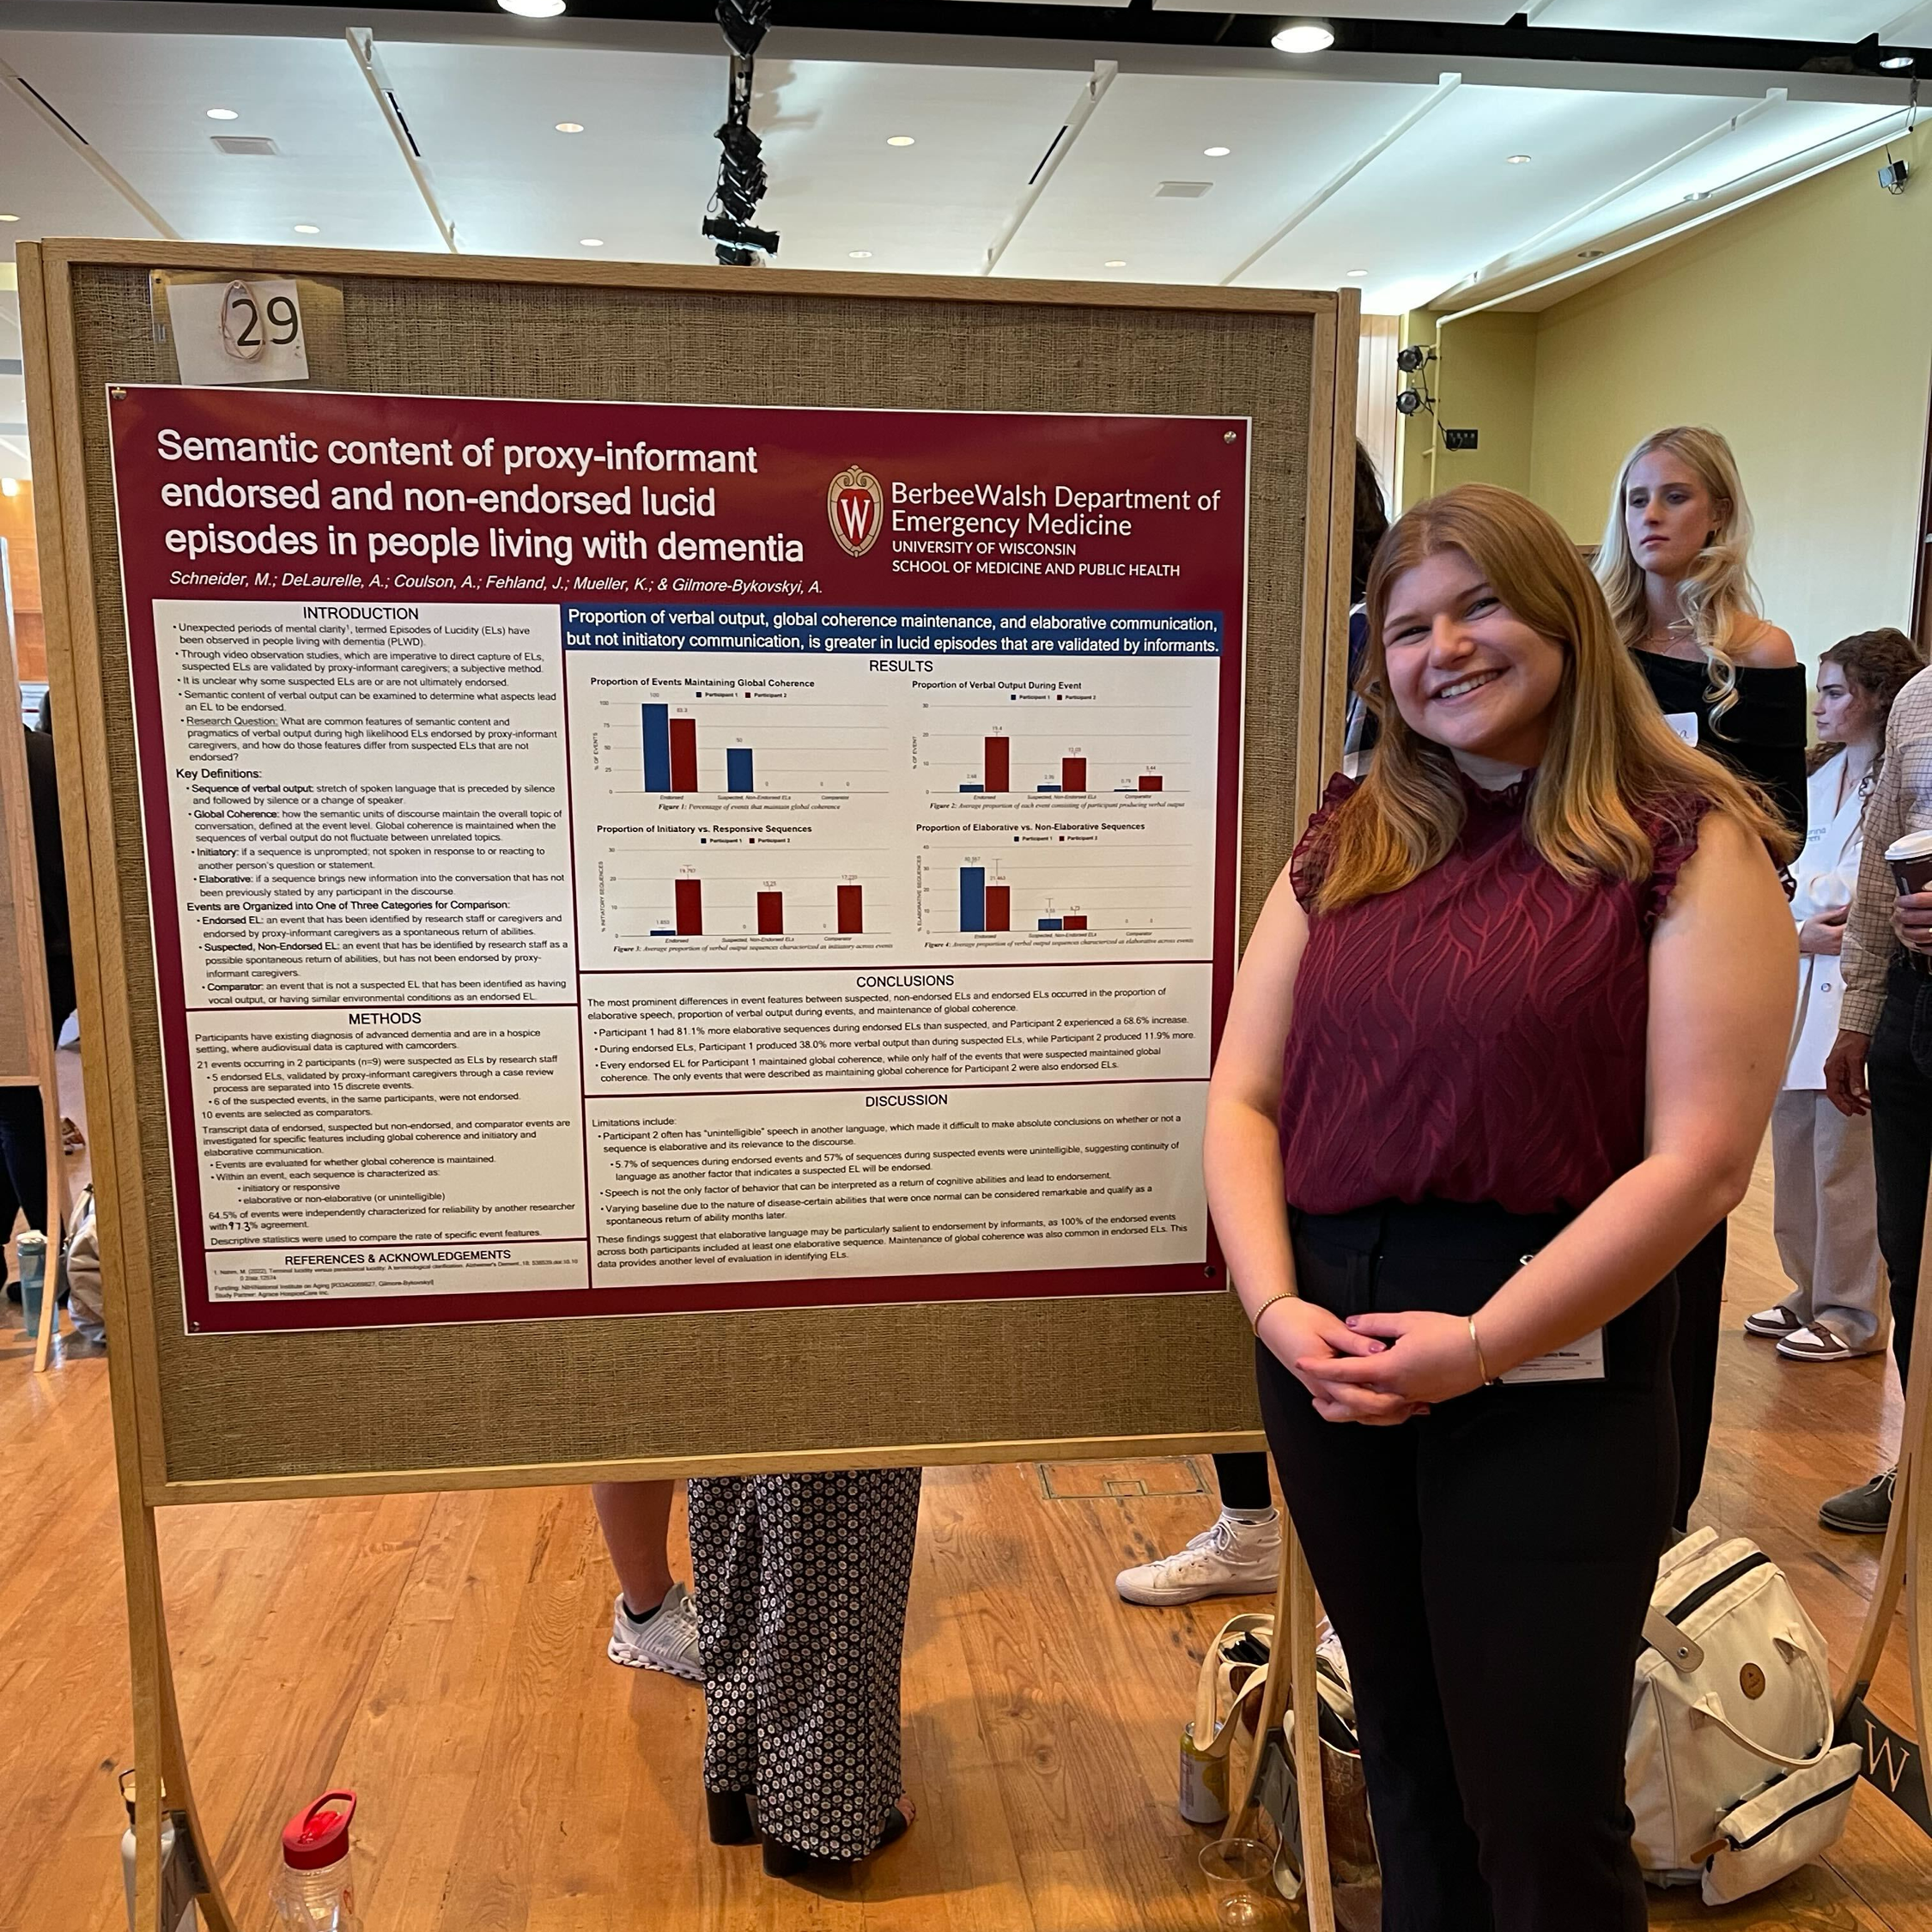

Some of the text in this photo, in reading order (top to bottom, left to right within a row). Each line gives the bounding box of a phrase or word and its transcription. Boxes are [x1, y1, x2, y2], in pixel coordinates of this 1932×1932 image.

[232, 295, 299, 347] 29
[157, 428, 757, 477] Semantic content of proxy-informant
[161, 477, 714, 516] endorsed and non-endorsed lucid
[891, 481, 1221, 512] BerbeeWalsh Department of
[840, 498, 871, 539] W
[892, 509, 1132, 538] Emergency Medicine
[165, 523, 803, 566] episodes in people living with dementia
[892, 540, 1076, 556] UNIVERSITY OF WISCONSIN
[892, 560, 1180, 576] SCHOOL OF MEDICINE AND PUBLIC HEALTH
[169, 570, 822, 596] Schneider, M.; DeLaurelle, A.; Coulson, A.; Fehland, J.; Mueller, K.; & Gilmore-Bykovskyi, A.
[303, 606, 418, 620] INTRODUCTION
[568, 608, 1217, 632] Proportion of verbal output, global coherence maintenance, and elaborative communication,
[179, 635, 204, 644] been
[205, 635, 249, 644] observed
[262, 636, 294, 647] people
[295, 636, 319, 647] living
[343, 637, 385, 646] dementia
[567, 631, 1218, 654] but not initiatory communication, is greater in lucid episodes that are validated by informants.
[869, 659, 933, 671] RESULTS
[590, 677, 638, 686] Proportion
[684, 677, 735, 688] Maintaining
[768, 678, 814, 687] Coherence
[912, 680, 957, 690] Proportion
[998, 681, 1026, 690] Output
[1028, 681, 1056, 690] During
[175, 768, 197, 781] Key
[597, 824, 643, 834] Proportion
[657, 824, 696, 834] Initiatory
[713, 824, 762, 834] Responsive
[765, 824, 812, 834] Sequences
[915, 823, 960, 833] Proportion
[1101, 823, 1145, 831] Sequences
[186, 902, 222, 911] Events
[242, 901, 293, 912] Organized
[295, 902, 313, 910] into
[315, 901, 336, 909] One
[338, 901, 348, 909] of
[349, 901, 379, 909] Three
[380, 900, 433, 911] Categories
[434, 900, 448, 908] for
[856, 975, 954, 987] CONCLUSIONS
[349, 1012, 421, 1024] METHODS
[194, 1034, 248, 1042] Participants
[275, 1032, 309, 1042] existing
[310, 1031, 353, 1041] diagnosis
[355, 1030, 363, 1039] of
[365, 1030, 409, 1039] advanced
[507, 1029, 540, 1038] hospice
[866, 1094, 947, 1107] DISCUSSION
[210, 1223, 228, 1231] with
[285, 1249, 511, 1265] REFERENCES & ACKNOWLEDGEMENTS
[618, 1259, 656, 1268] provides
[659, 1257, 692, 1266] another
[694, 1255, 714, 1264] level
[716, 1255, 726, 1263] of
[784, 1252, 828, 1261] identifying
[1865, 1719, 1910, 1793] W
